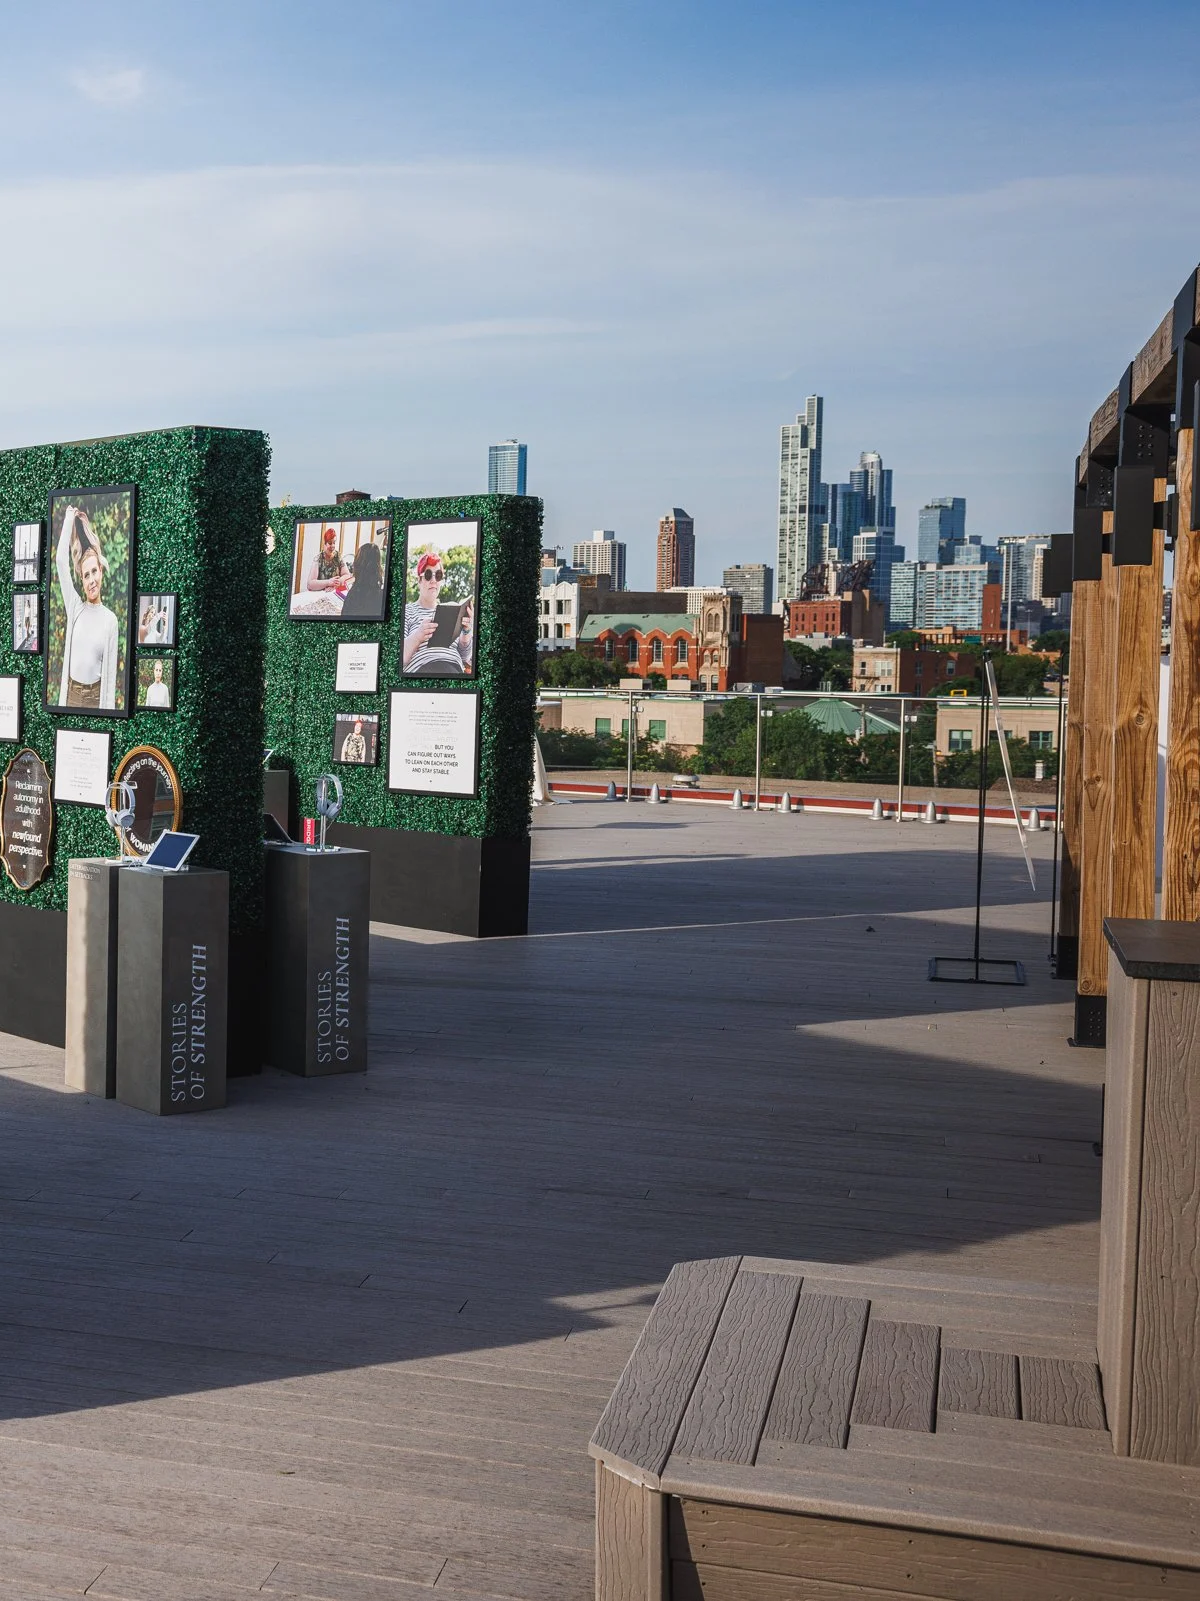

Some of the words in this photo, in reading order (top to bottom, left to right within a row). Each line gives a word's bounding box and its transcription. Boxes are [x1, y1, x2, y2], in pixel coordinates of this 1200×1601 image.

[140, 758, 148, 766] on
[148, 757, 157, 768] the
[14, 781, 43, 794] Reclaiming
[13, 794, 38, 806] autonomy
[14, 805, 41, 816] adulthood
[22, 819, 33, 828] with
[12, 831, 42, 843] newfound
[8, 844, 44, 858] perspective.
[335, 917, 350, 1028] STRENGTH
[191, 944, 207, 1064] STRENGTH
[317, 971, 332, 1063] STORIES
[171, 1002, 187, 1102] STORIES
[335, 1034, 349, 1060] OF
[190, 1071, 205, 1100] OF
